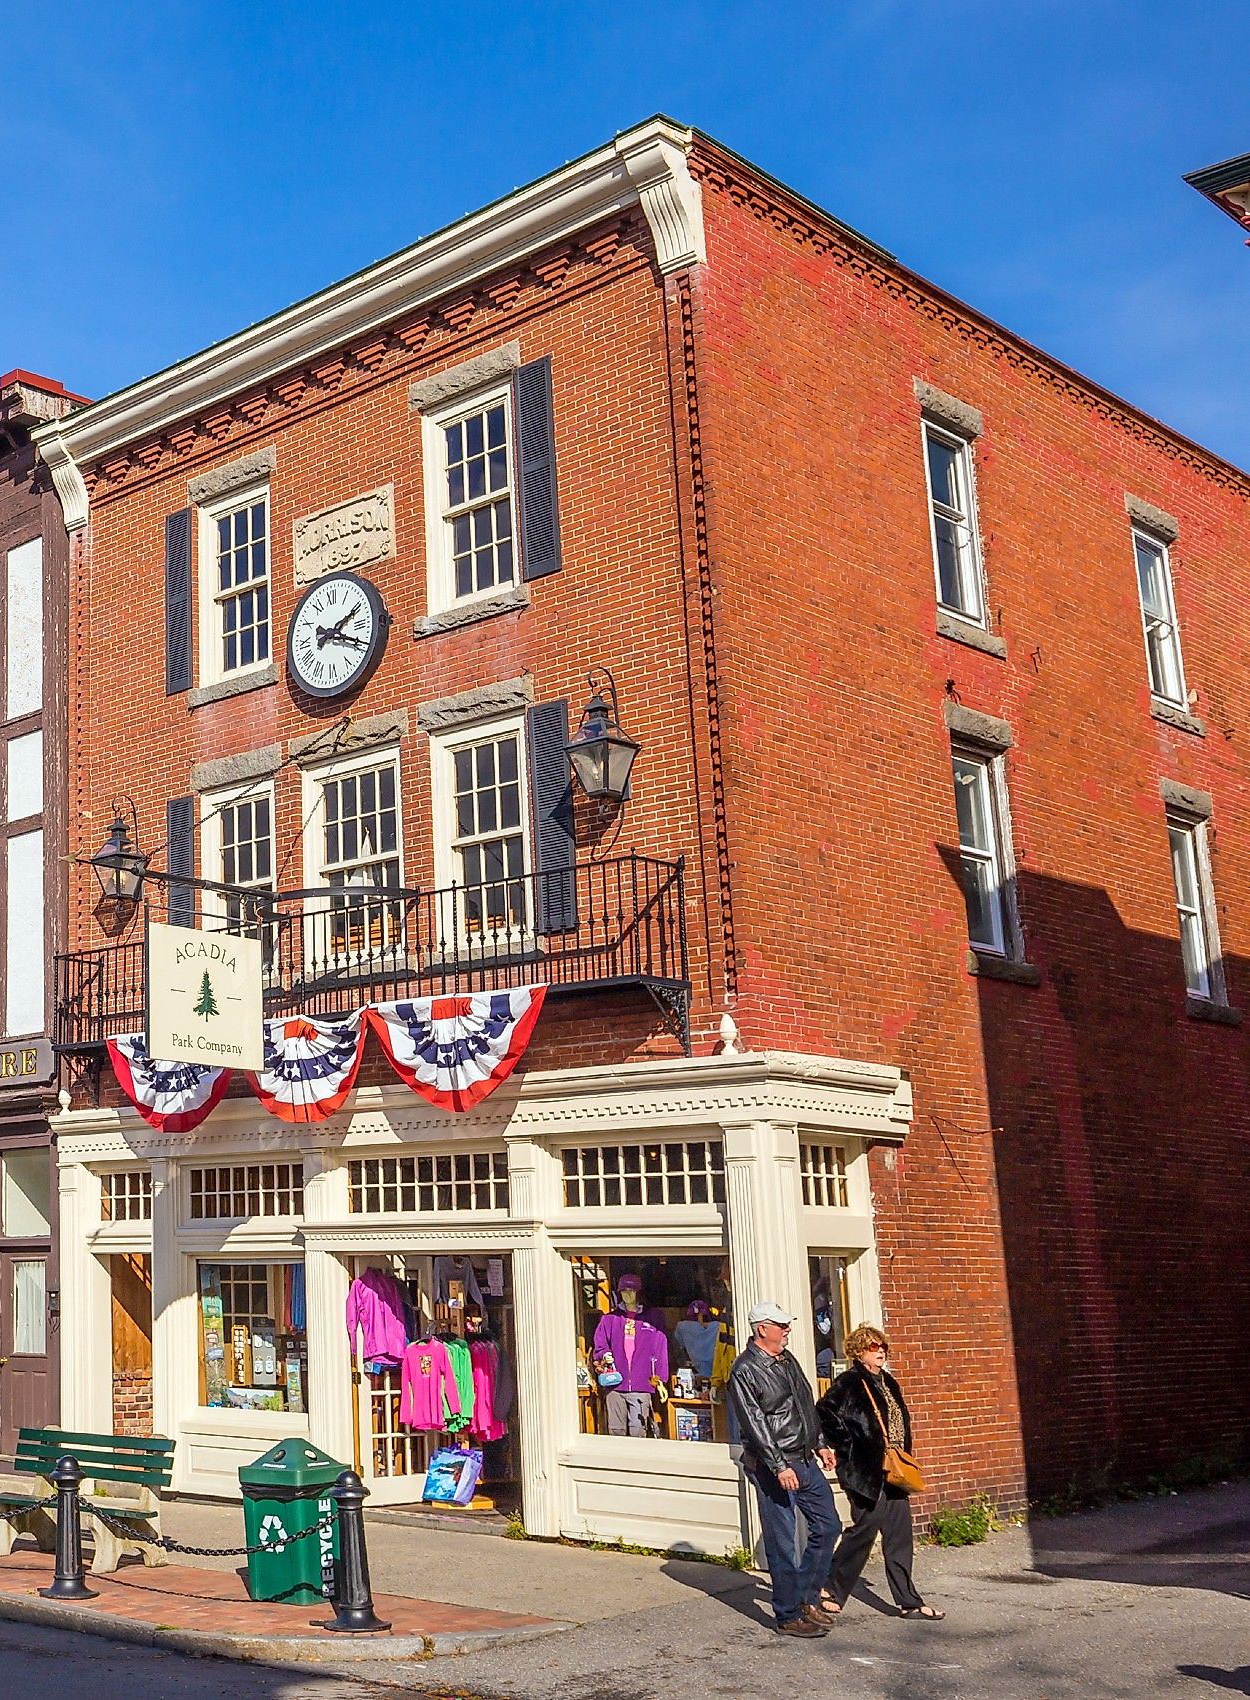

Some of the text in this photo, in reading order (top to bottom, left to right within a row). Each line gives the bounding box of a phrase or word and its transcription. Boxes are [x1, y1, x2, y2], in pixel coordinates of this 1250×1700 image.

[320, 541, 366, 573] 1897
[175, 942, 236, 974] ACADIA
[172, 1033, 243, 1056] Park Company
[318, 1498, 335, 1599] RECYCLE
